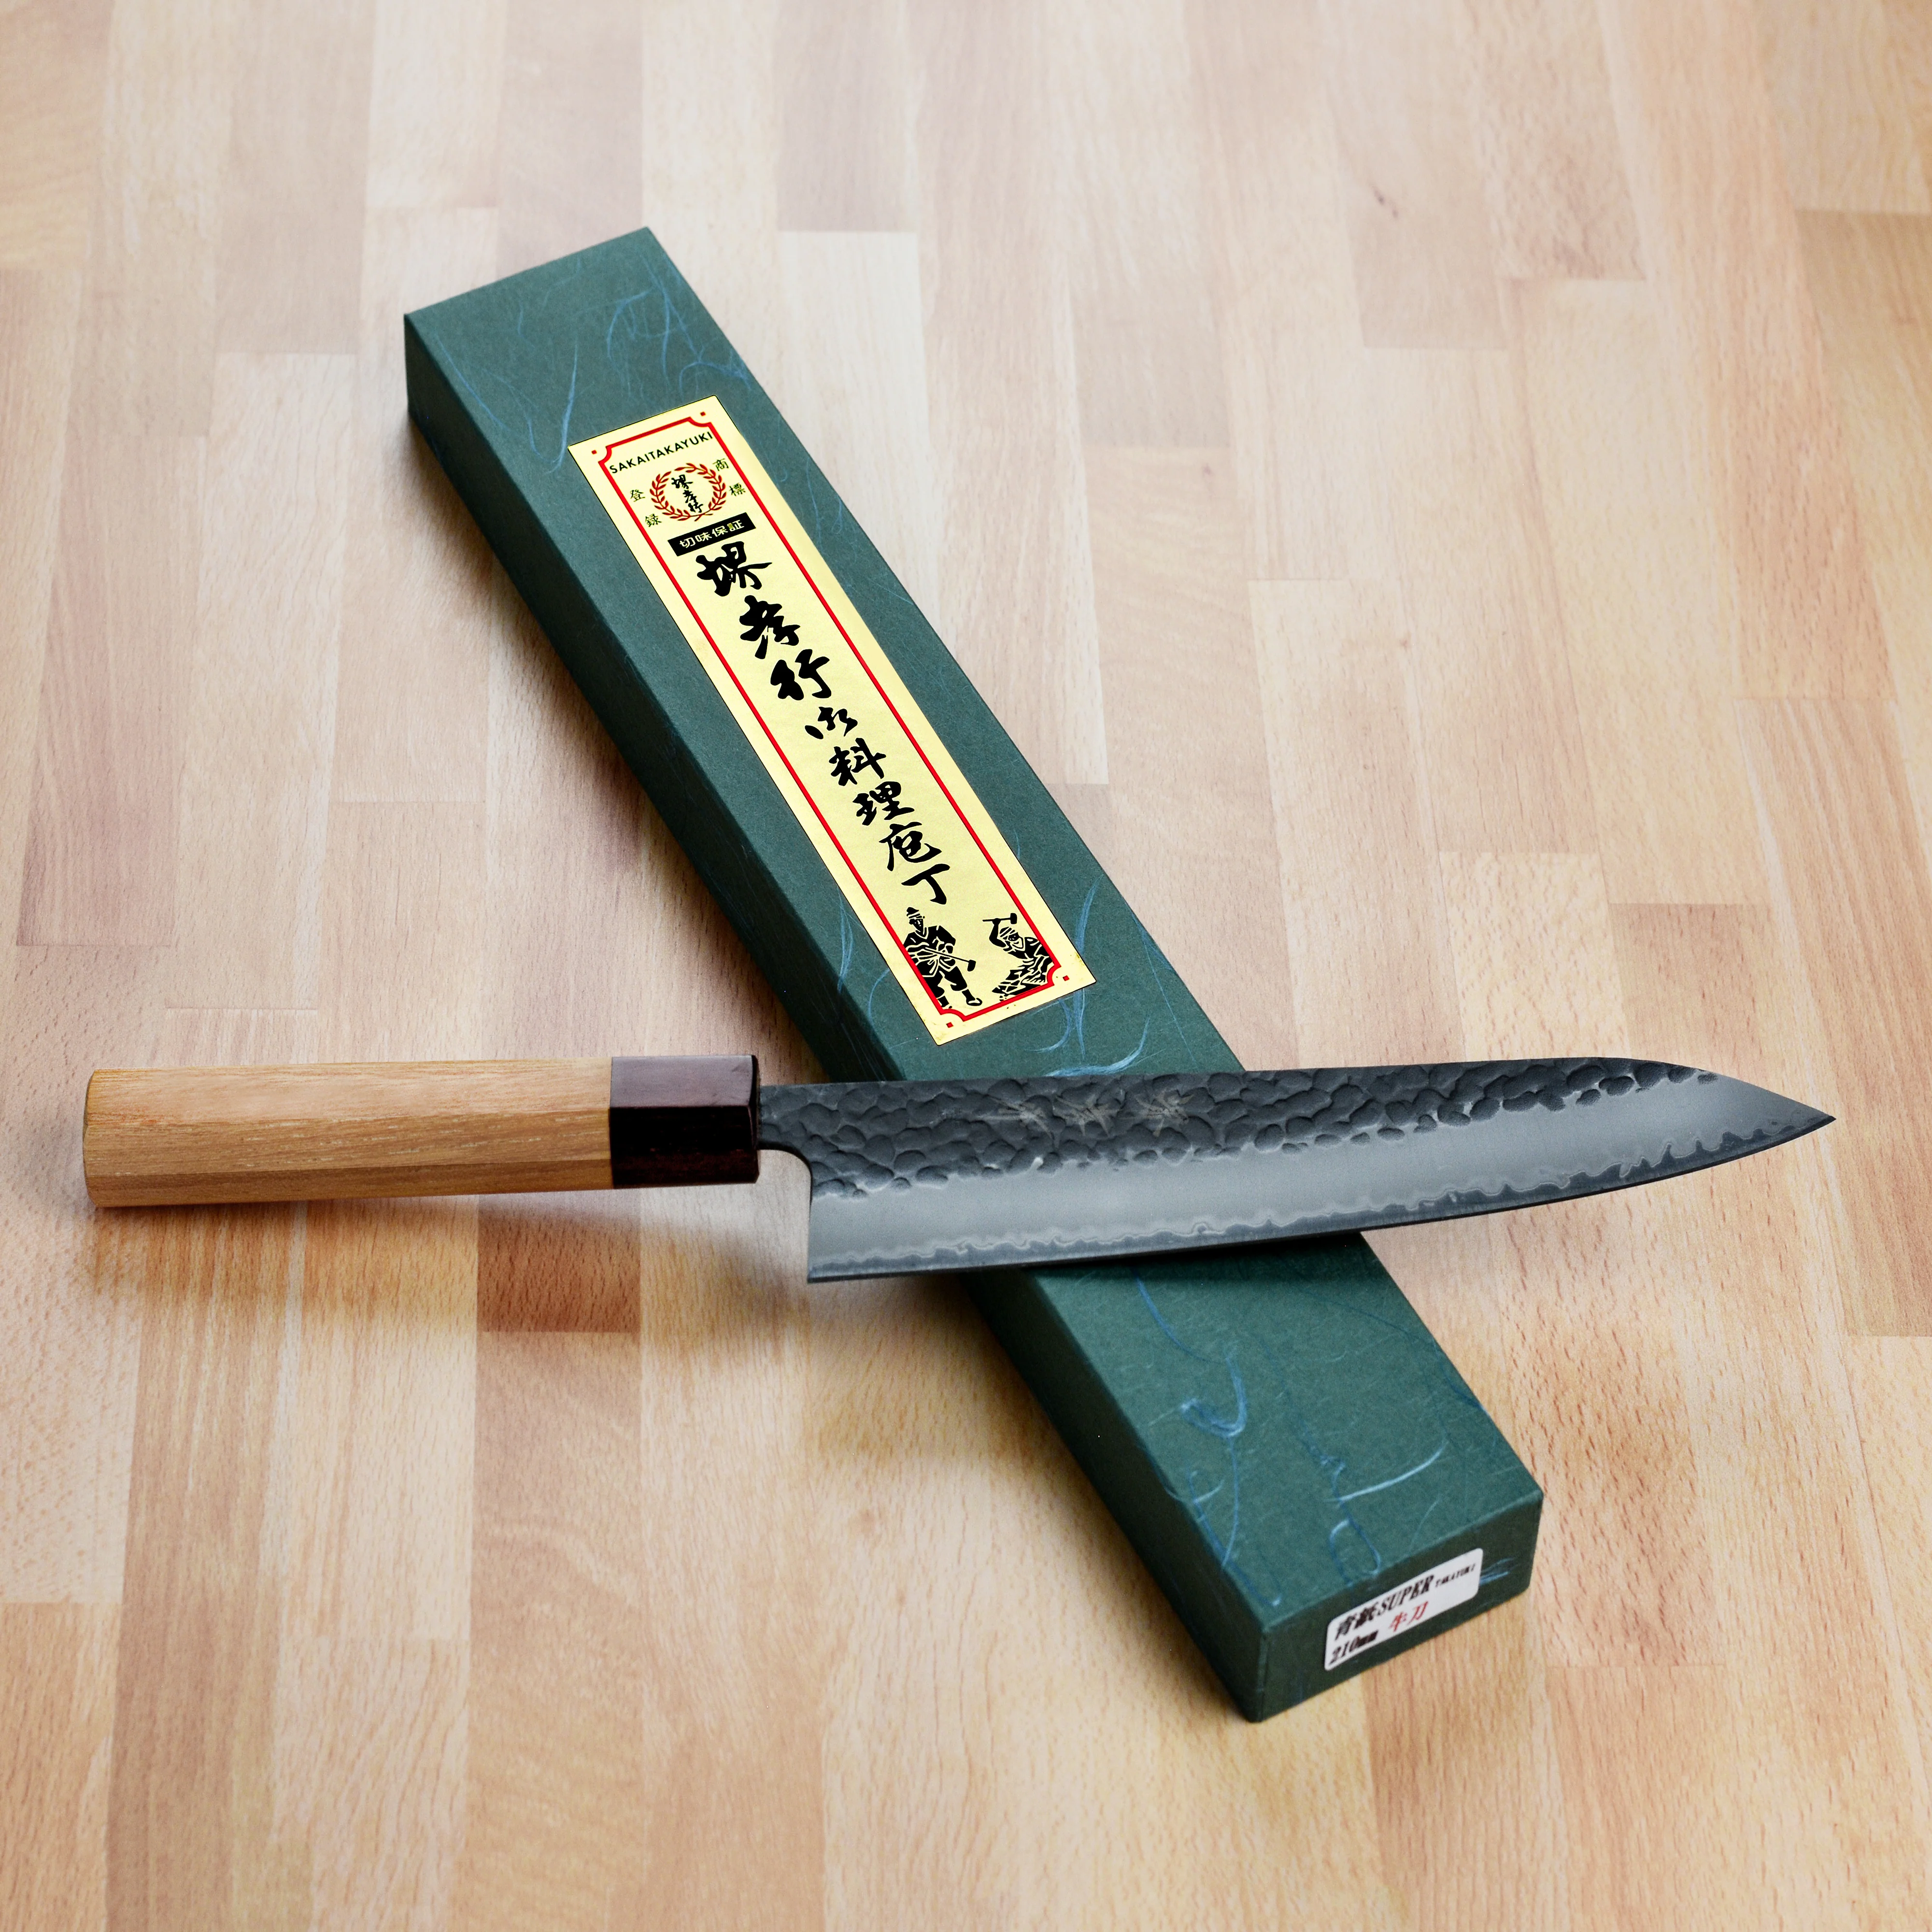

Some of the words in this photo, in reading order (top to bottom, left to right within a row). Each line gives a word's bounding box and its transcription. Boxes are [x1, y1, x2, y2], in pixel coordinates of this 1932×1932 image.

[610, 431, 713, 474] SAKAITAKAYUKI
[712, 458, 746, 497] 商標
[630, 489, 662, 527] 登録
[680, 520, 744, 548] 切味保証
